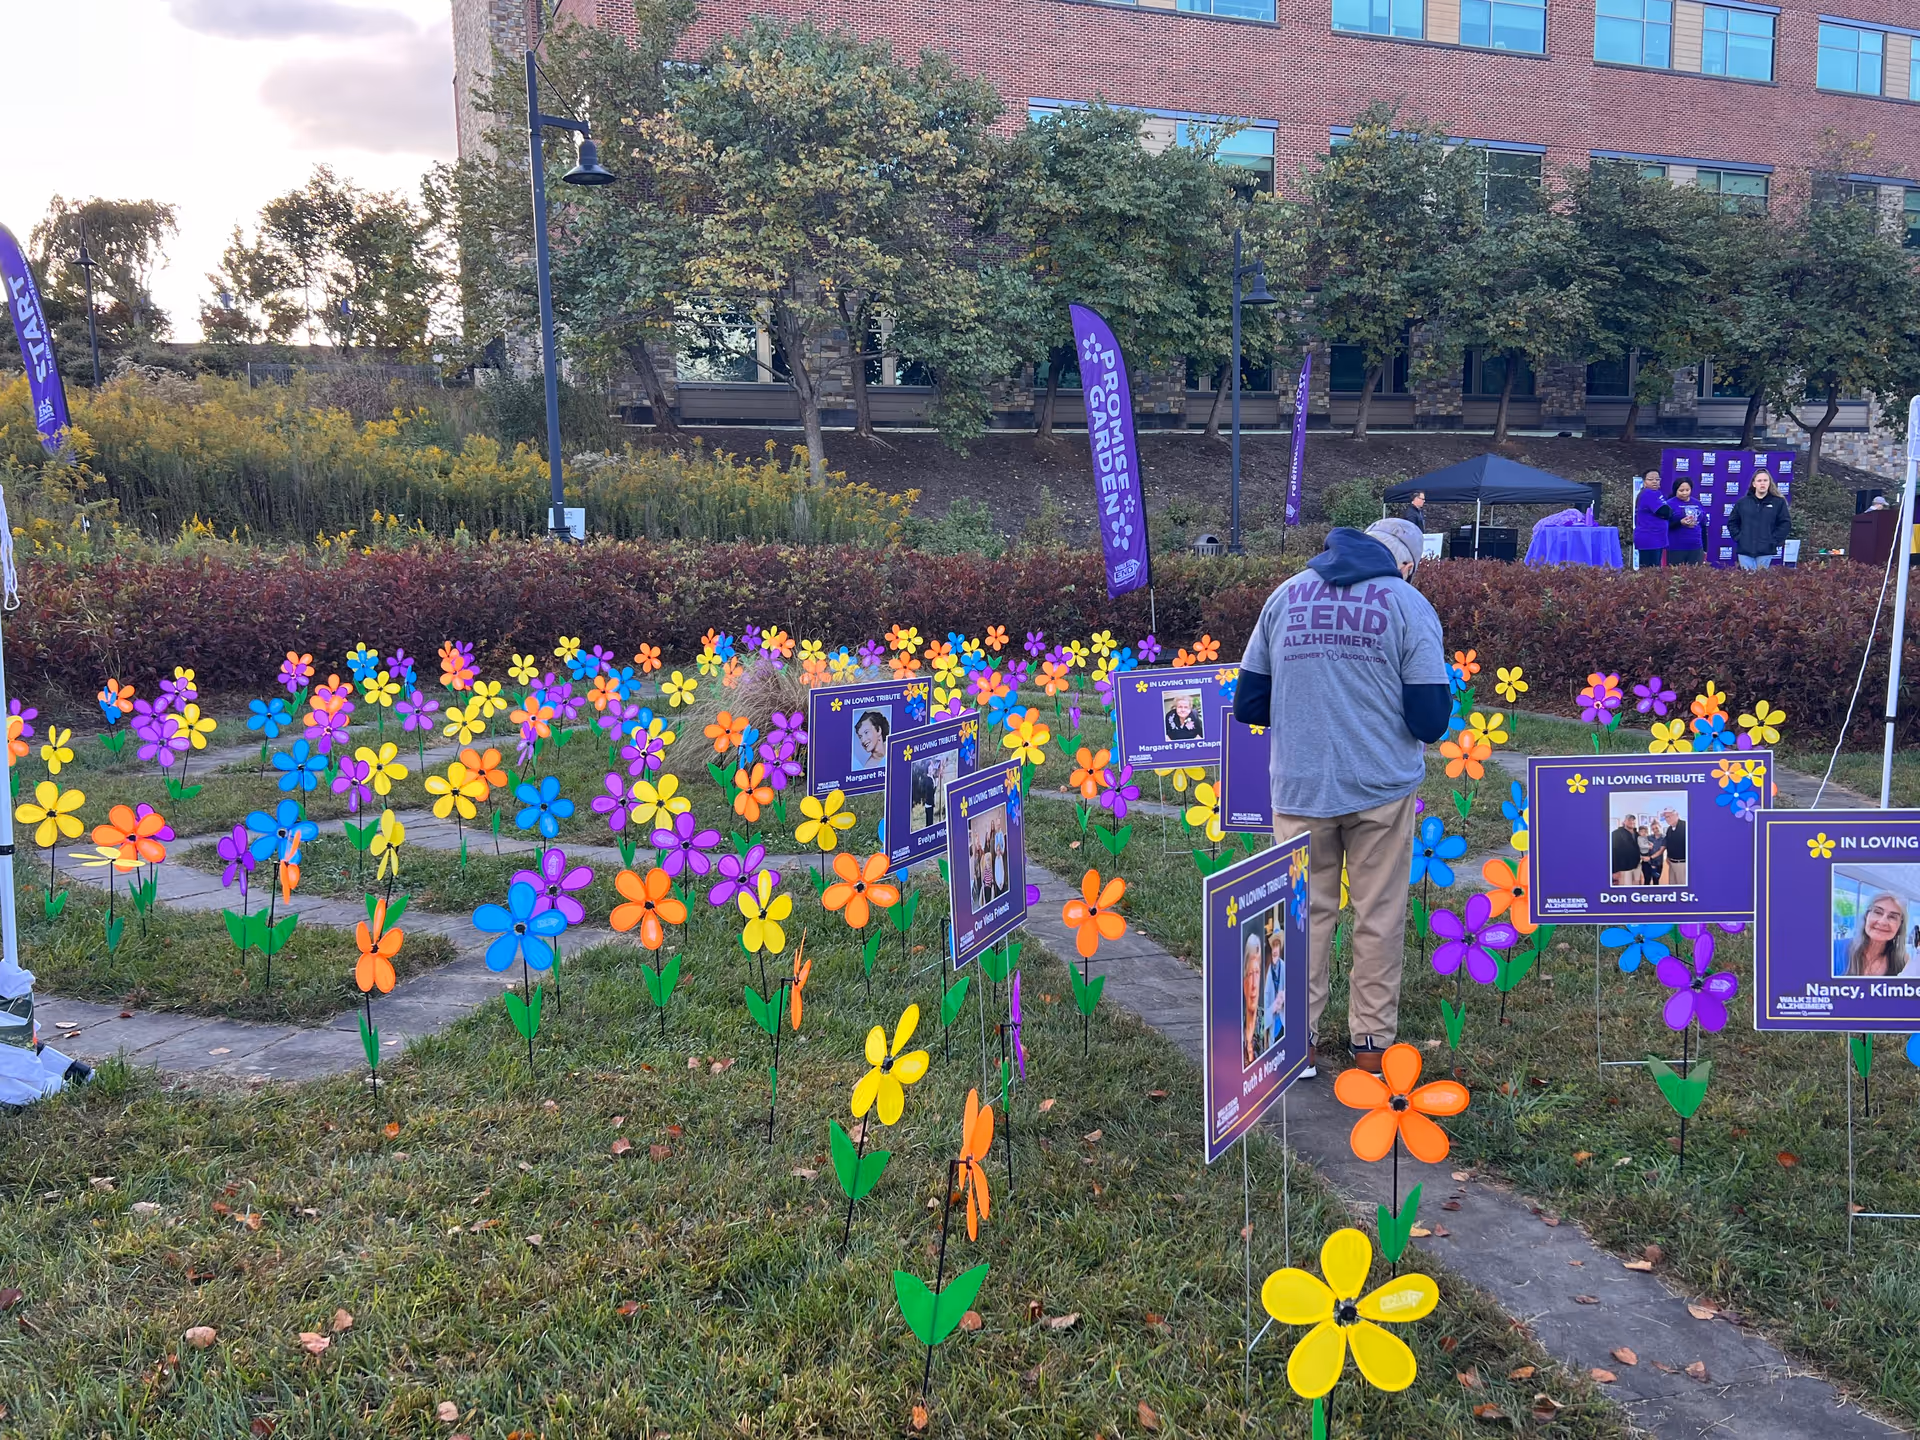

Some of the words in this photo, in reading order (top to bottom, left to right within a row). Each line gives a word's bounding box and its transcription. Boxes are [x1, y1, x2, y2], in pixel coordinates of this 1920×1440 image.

[8, 276, 47, 384] START
[1100, 350, 1130, 492] PROMISE
[1089, 385, 1120, 516] GARDEN
[1288, 580, 1392, 610] WALK
[1290, 614, 1304, 624] TO
[1311, 605, 1388, 635] END
[1283, 634, 1384, 651] ALZHEIMER'S
[1340, 652, 1387, 664] ASSOCIATION
[852, 696, 875, 704] LOVING
[876, 693, 900, 701] TRIBUTE
[914, 744, 920, 752] IN
[920, 740, 937, 751] LOVING
[938, 734, 957, 745] TRIBUTE
[1139, 744, 1172, 752] Margaret
[845, 772, 876, 783] Margaret
[1592, 776, 1605, 785] IN
[1607, 775, 1652, 785] LOVING
[1655, 774, 1706, 784] TRIBUTE
[973, 790, 988, 804] LOVING
[988, 784, 1004, 799] TRIBUTE
[918, 832, 935, 845] Evelyn
[1840, 837, 1856, 848] IN
[1861, 836, 1918, 848] LOVING
[1238, 896, 1245, 910] IN
[1246, 884, 1266, 906] LOVING
[1267, 873, 1287, 895] TRIBUTE
[1600, 893, 1627, 903] Don
[1630, 892, 1677, 902] Gerard
[1680, 892, 1699, 902] Sr.
[974, 920, 983, 932] Our
[983, 912, 994, 927] Vista
[994, 902, 1010, 920] Friends
[1806, 983, 1865, 999] Nancy,
[1871, 983, 1920, 997] Kimbe
[1243, 1072, 1257, 1096] Ruth
[1258, 1068, 1263, 1082] &
[1264, 1050, 1285, 1077] Margine
